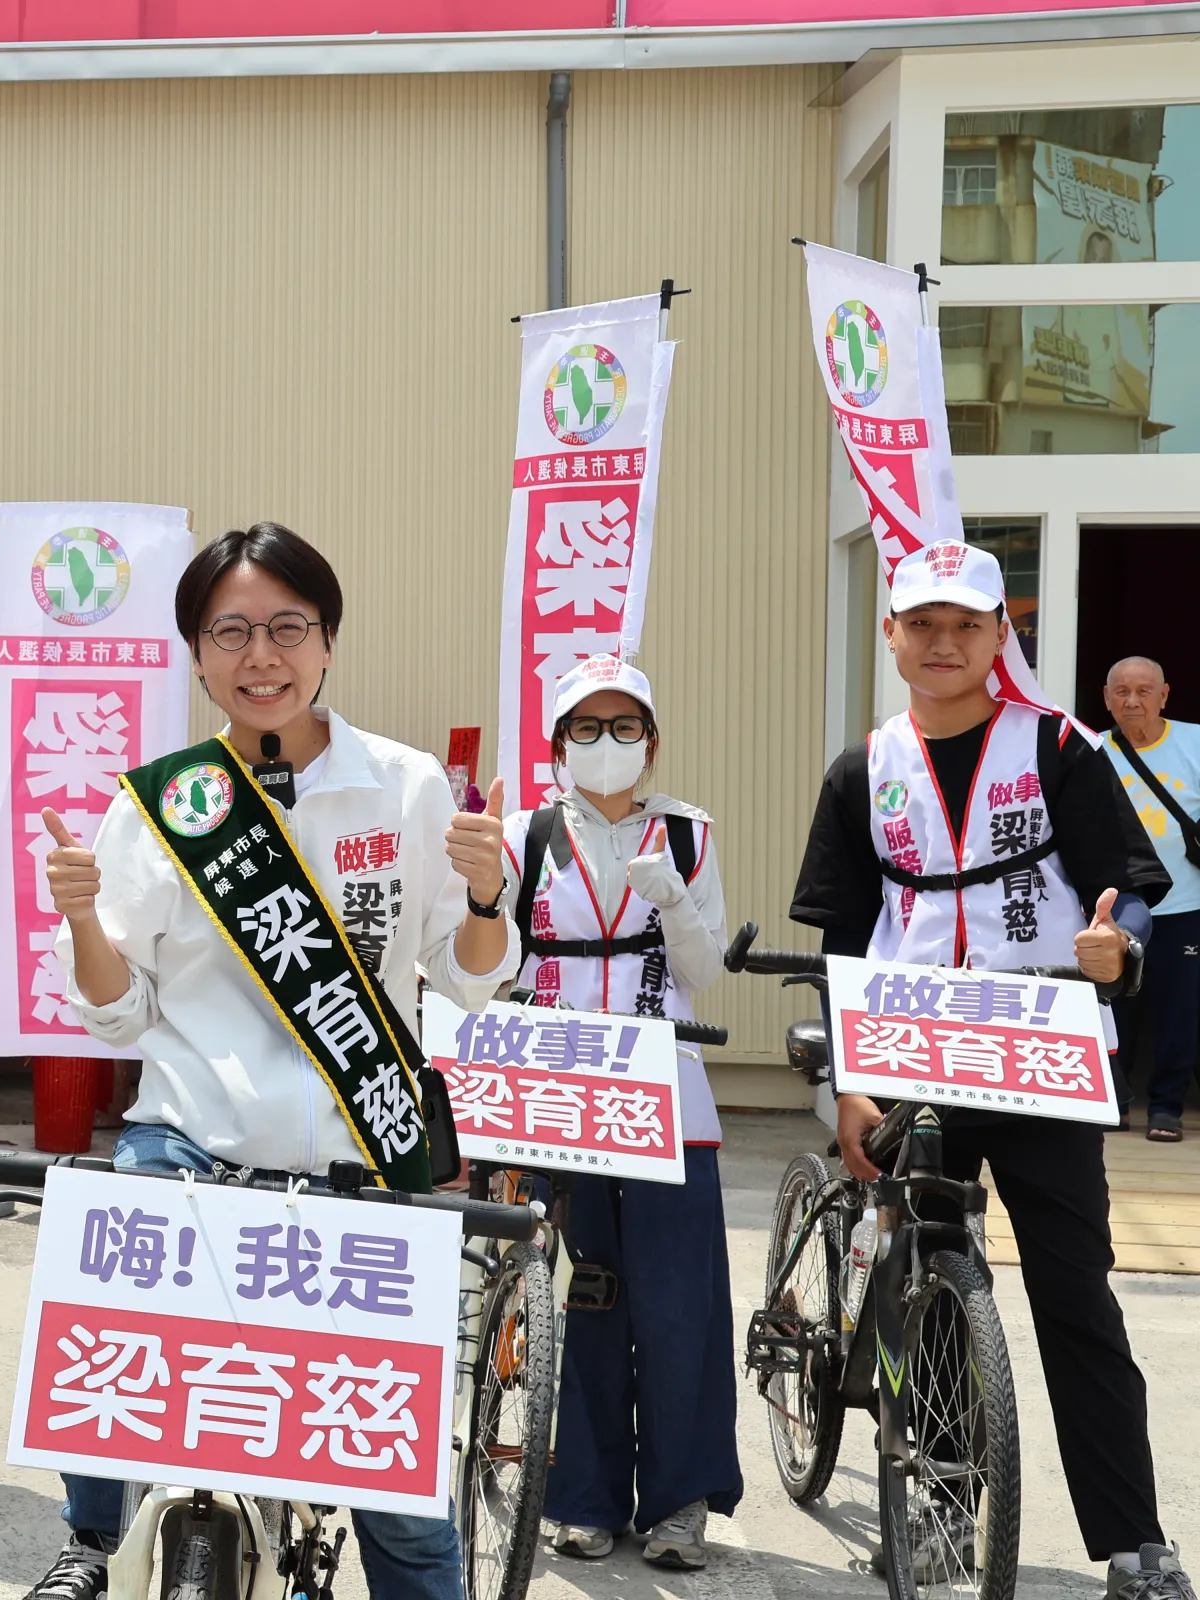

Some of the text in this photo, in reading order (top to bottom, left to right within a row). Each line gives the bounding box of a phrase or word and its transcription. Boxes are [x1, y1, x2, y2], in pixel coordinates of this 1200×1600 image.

[924, 544, 968, 564] 做事!
[930, 559, 963, 572] 做事!
[203, 823, 270, 881] 屏東市長
[214, 845, 282, 897] 候選人
[1029, 808, 1049, 903] 屏東市候選人
[342, 881, 389, 974] 梁育
[236, 883, 424, 1164] 梁育慈
[863, 972, 1060, 1027] 做事!
[455, 1012, 642, 1073] 做事!
[853, 1017, 1095, 1093] 梁育慈
[443, 1066, 665, 1148] 梁育慈
[79, 1206, 415, 1318] 嗨! 我是
[46, 1324, 421, 1471] 梁育慈
